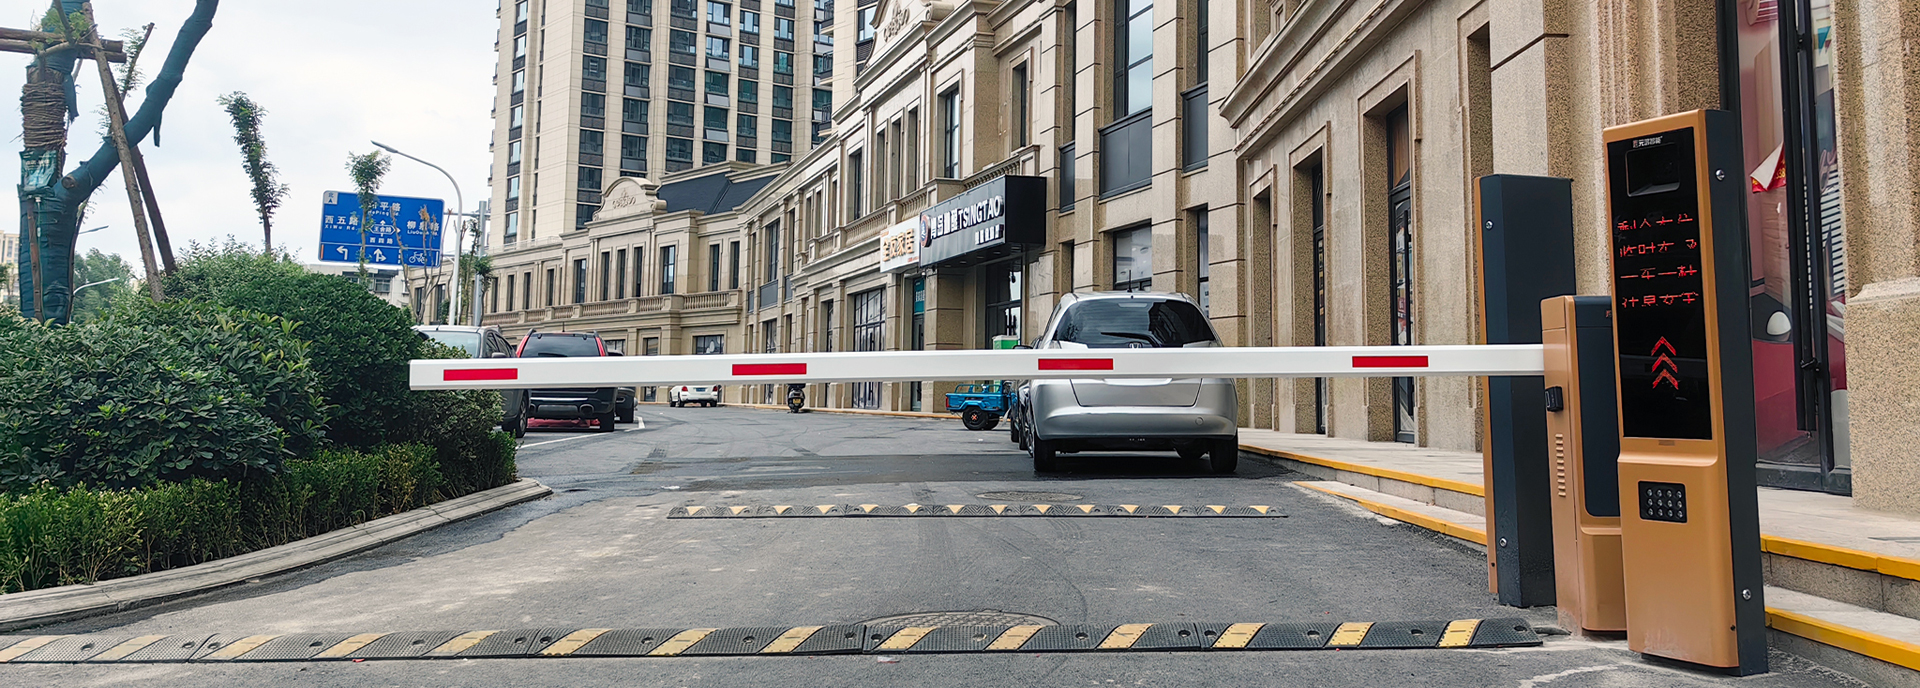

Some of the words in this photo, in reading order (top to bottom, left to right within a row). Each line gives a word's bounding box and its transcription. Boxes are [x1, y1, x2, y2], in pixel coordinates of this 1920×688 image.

[325, 214, 359, 226] 西五路
[958, 195, 1002, 229] TSINGTAO
